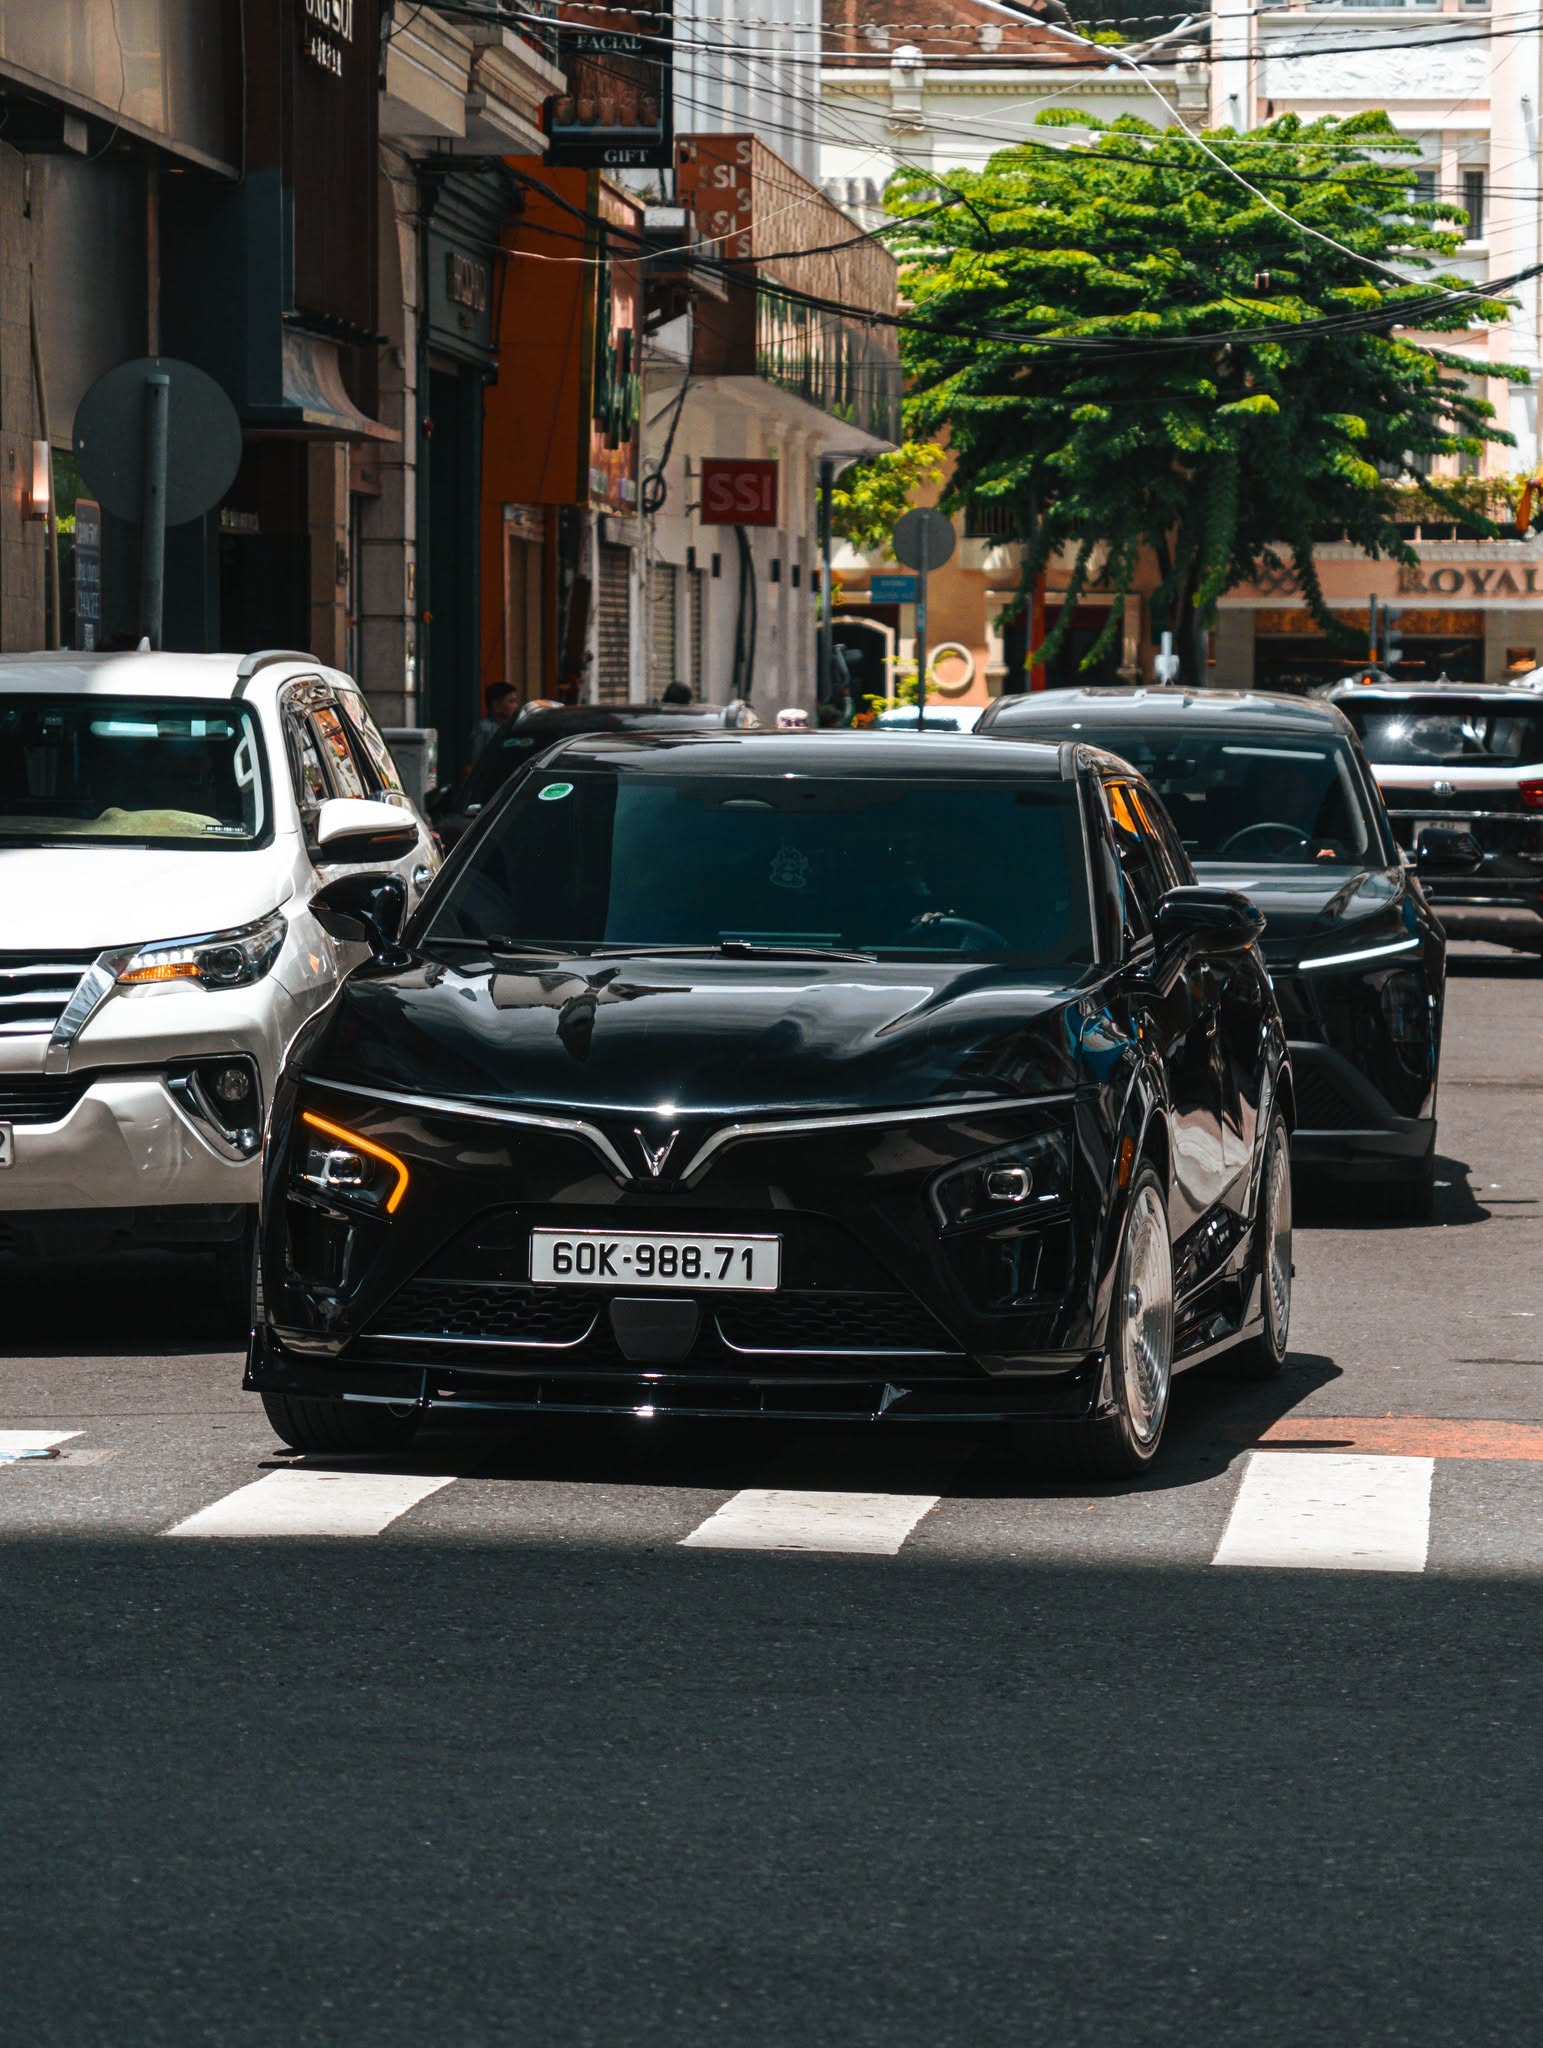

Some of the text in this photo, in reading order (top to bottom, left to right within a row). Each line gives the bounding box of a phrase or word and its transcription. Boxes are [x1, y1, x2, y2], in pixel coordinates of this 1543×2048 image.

[577, 35, 642, 50] FACIAL
[604, 149, 649, 163] GIFT
[707, 472, 771, 512] SSI
[1398, 568, 1543, 594] ROYAL
[553, 1240, 754, 1281] 60K-988.71
